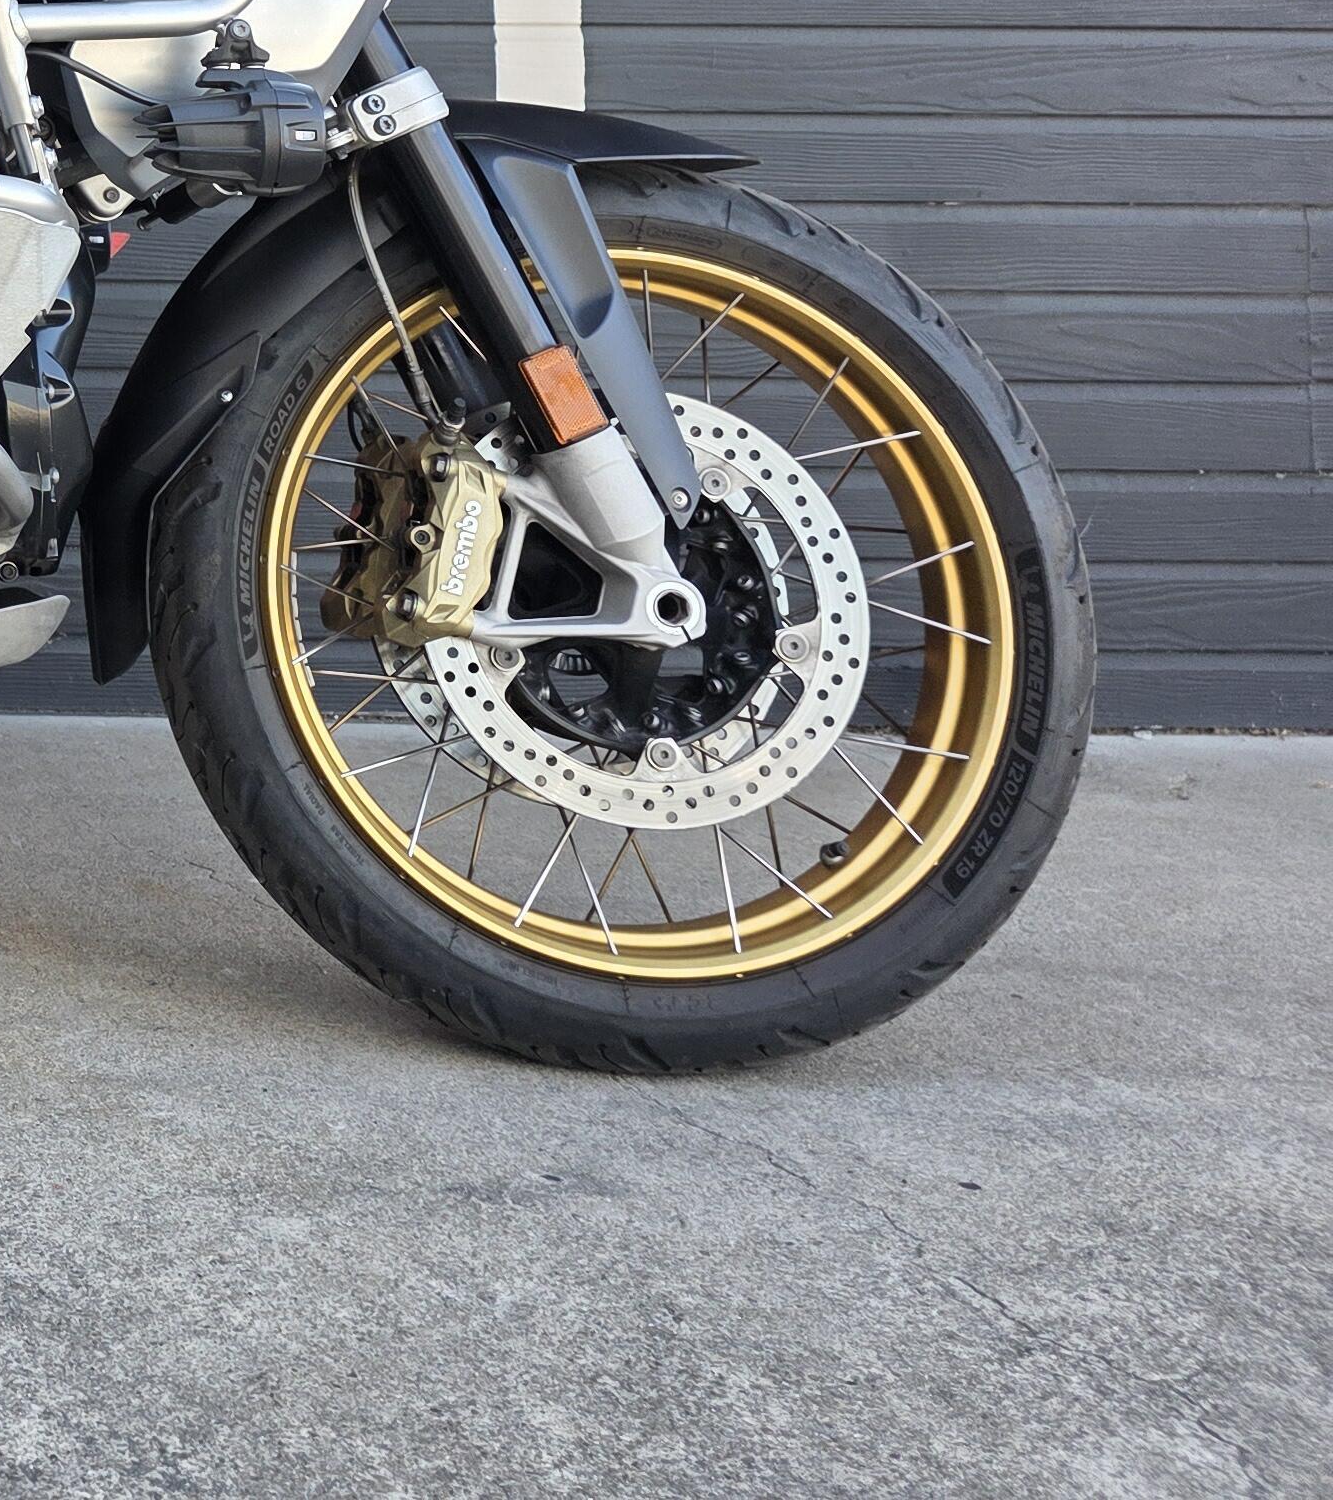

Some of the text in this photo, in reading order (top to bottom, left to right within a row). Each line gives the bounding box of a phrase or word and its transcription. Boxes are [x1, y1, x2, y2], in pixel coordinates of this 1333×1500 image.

[238, 376, 309, 608] MICHELIN ROAD 6
[440, 500, 482, 596] brembo
[956, 605, 1046, 881] MICHELIN 120/70 ZR 19
